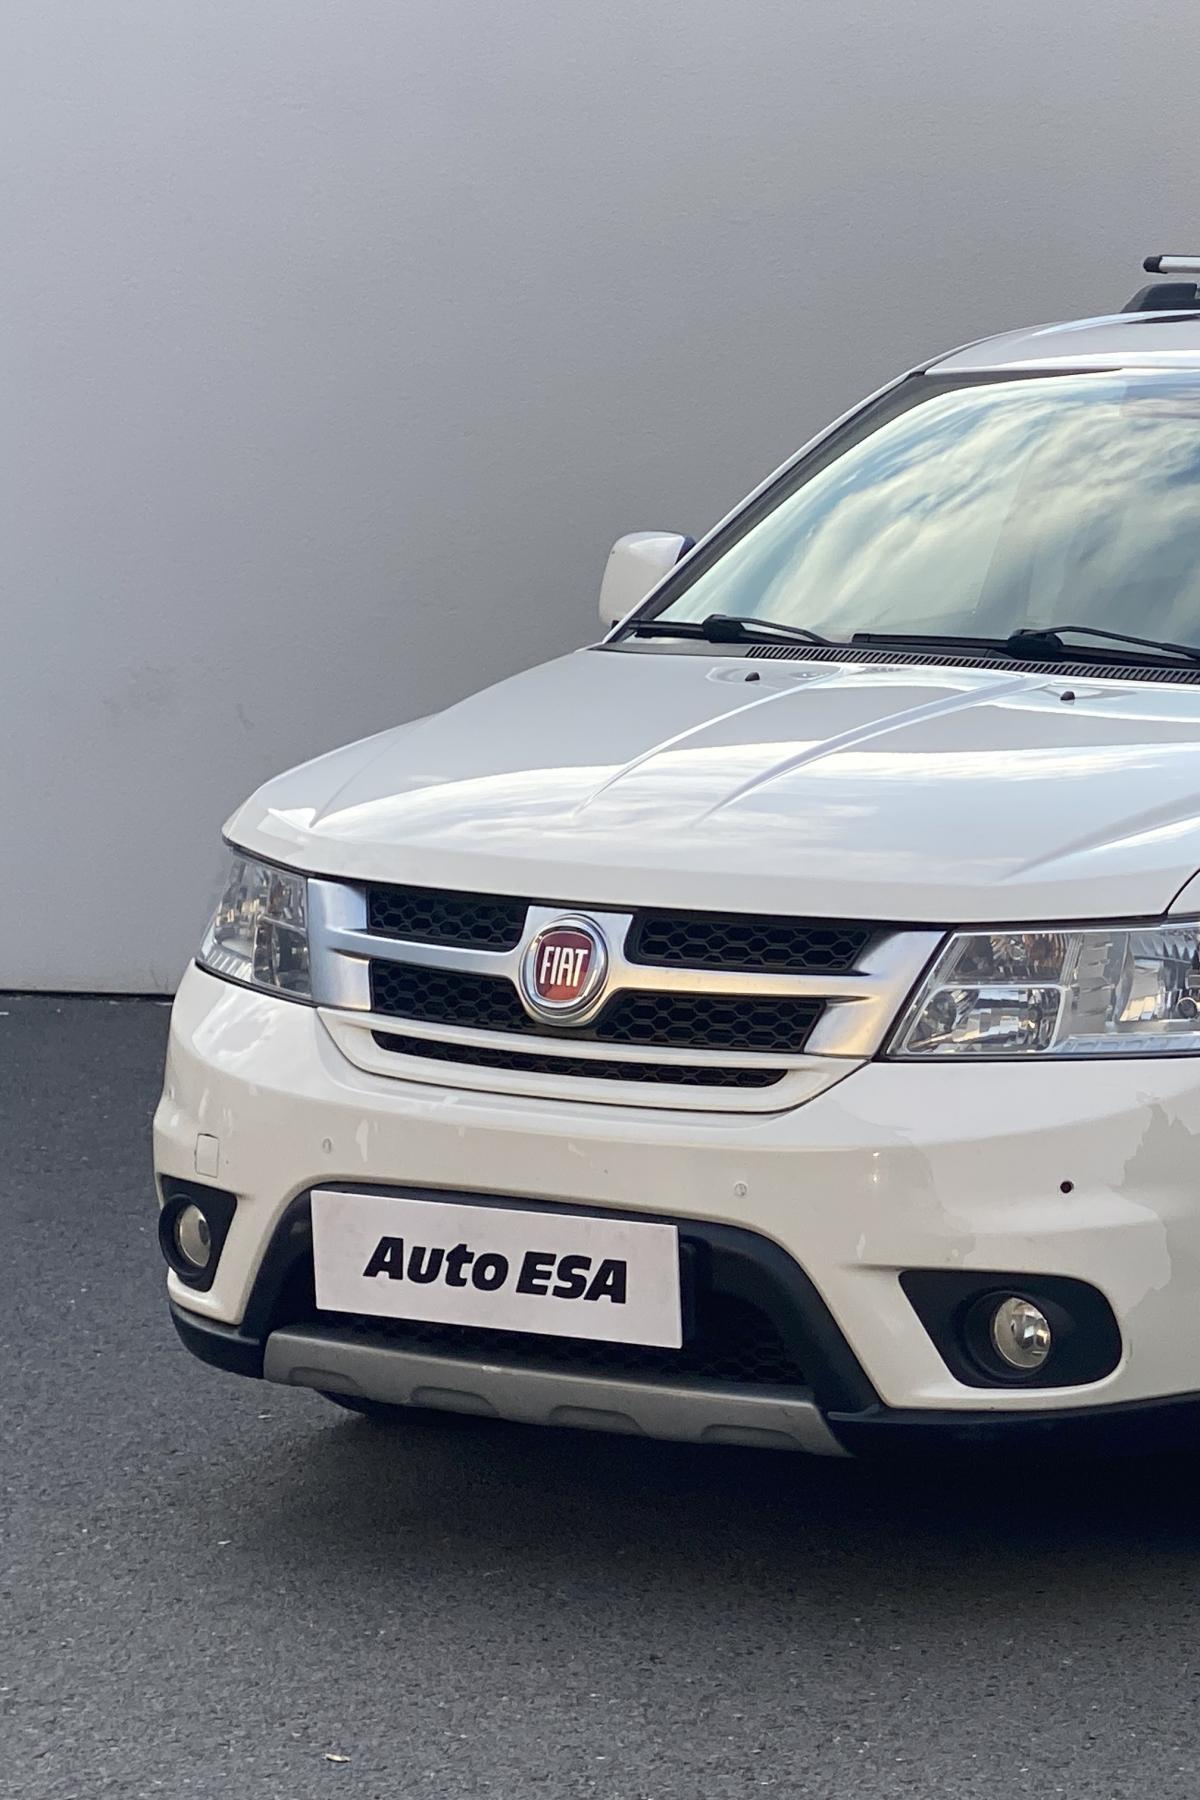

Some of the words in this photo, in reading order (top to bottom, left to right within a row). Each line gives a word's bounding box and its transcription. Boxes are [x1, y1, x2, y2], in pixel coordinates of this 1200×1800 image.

[539, 945, 589, 988] FIAT
[362, 1236, 510, 1292] Auto
[515, 1251, 628, 1305] ESA
